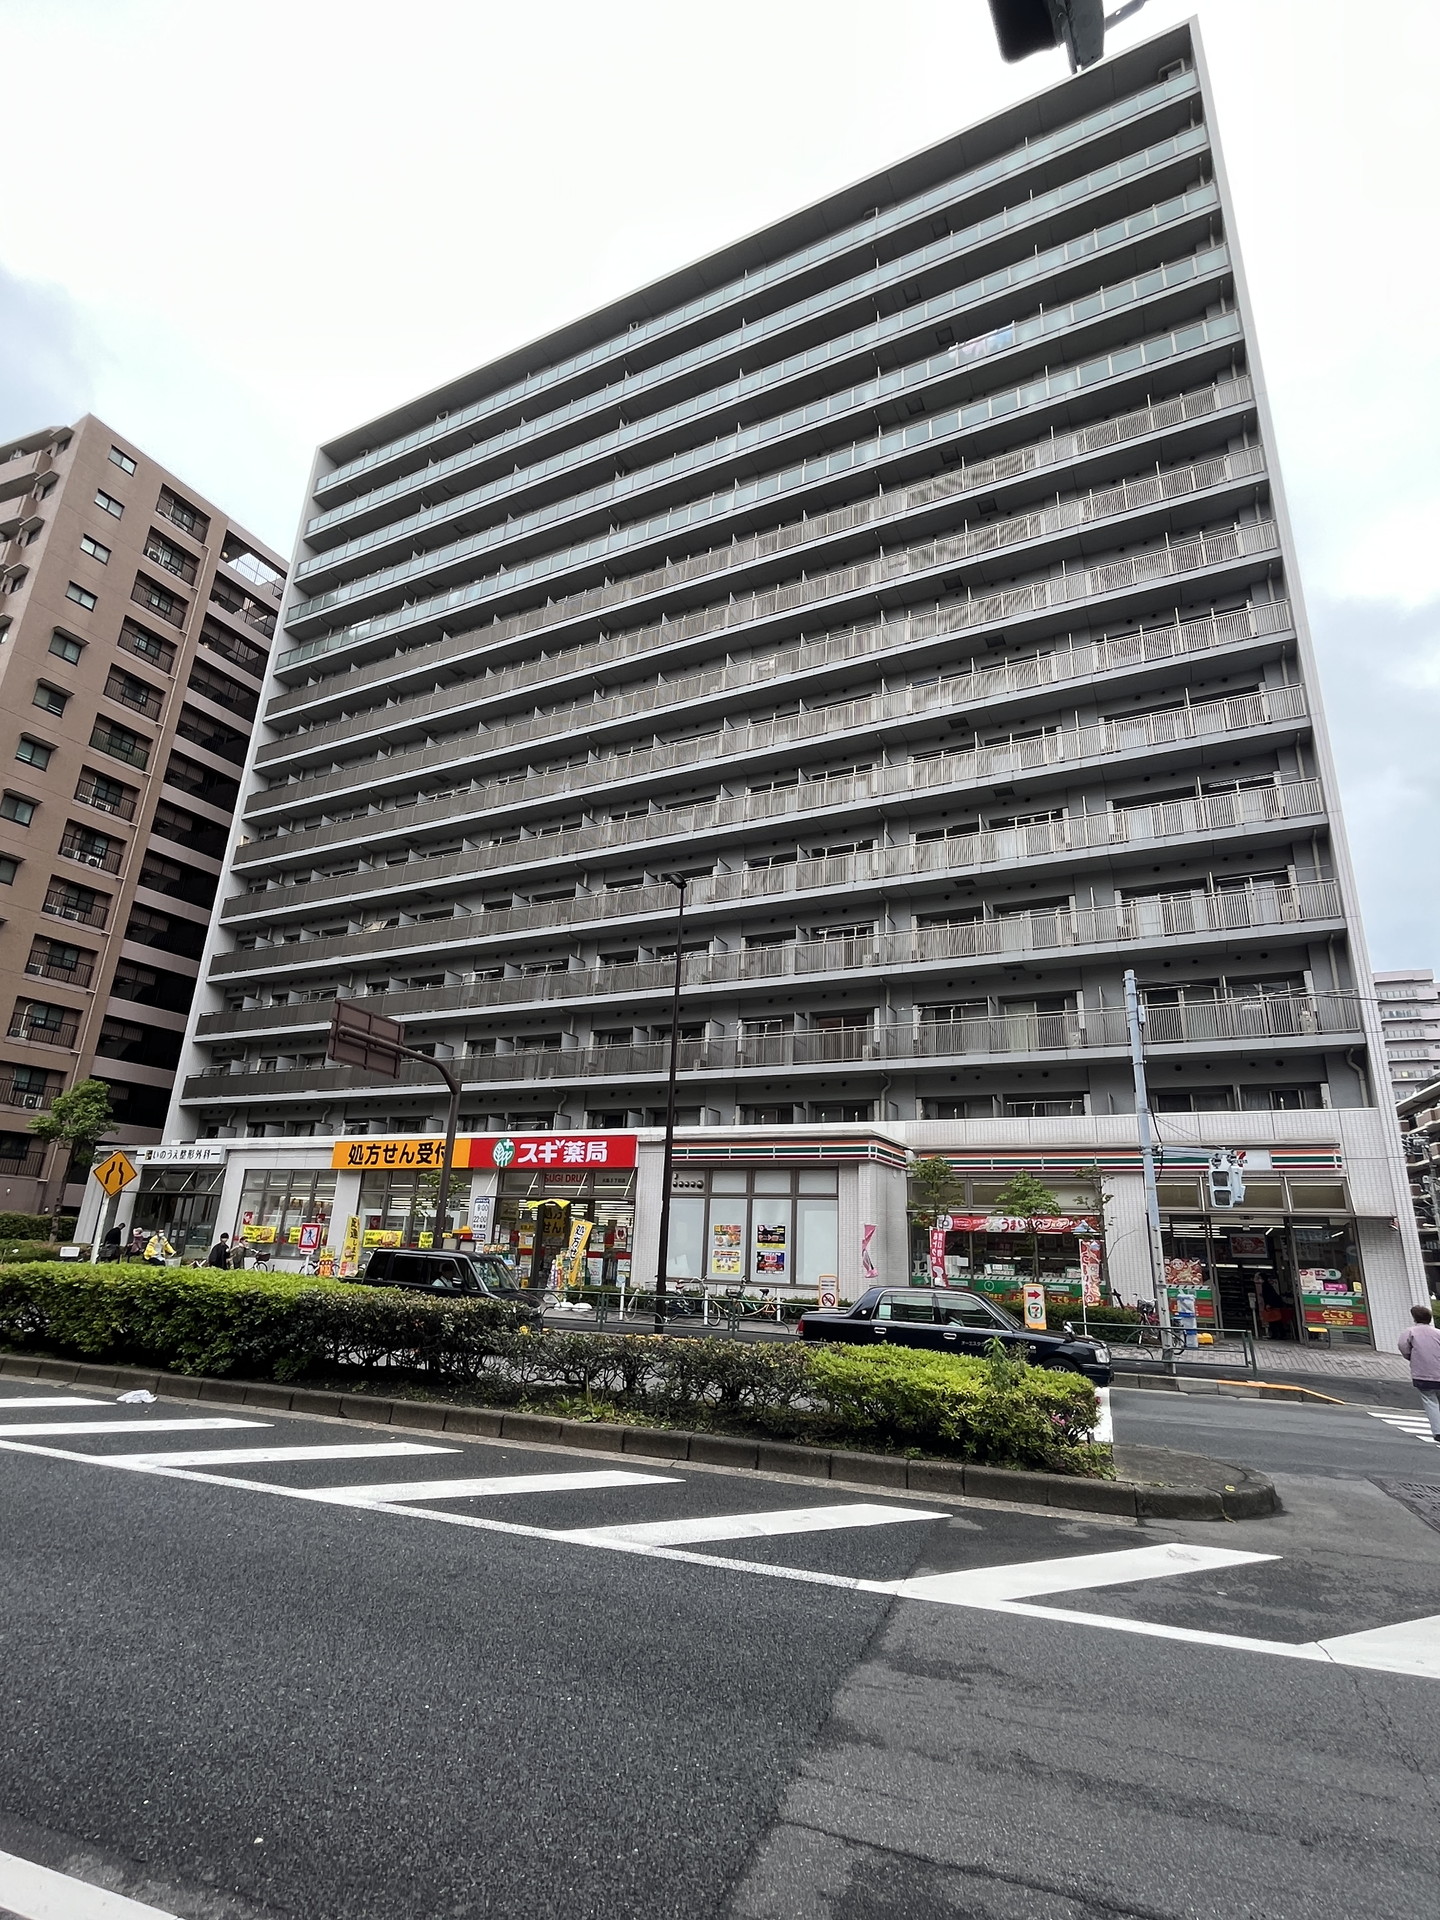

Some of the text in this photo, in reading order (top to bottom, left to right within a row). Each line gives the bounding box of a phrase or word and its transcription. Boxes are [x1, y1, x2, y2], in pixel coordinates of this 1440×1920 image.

[153, 1149, 211, 1160] いのうえ整形外科
[517, 1139, 608, 1163] スギ薬局
